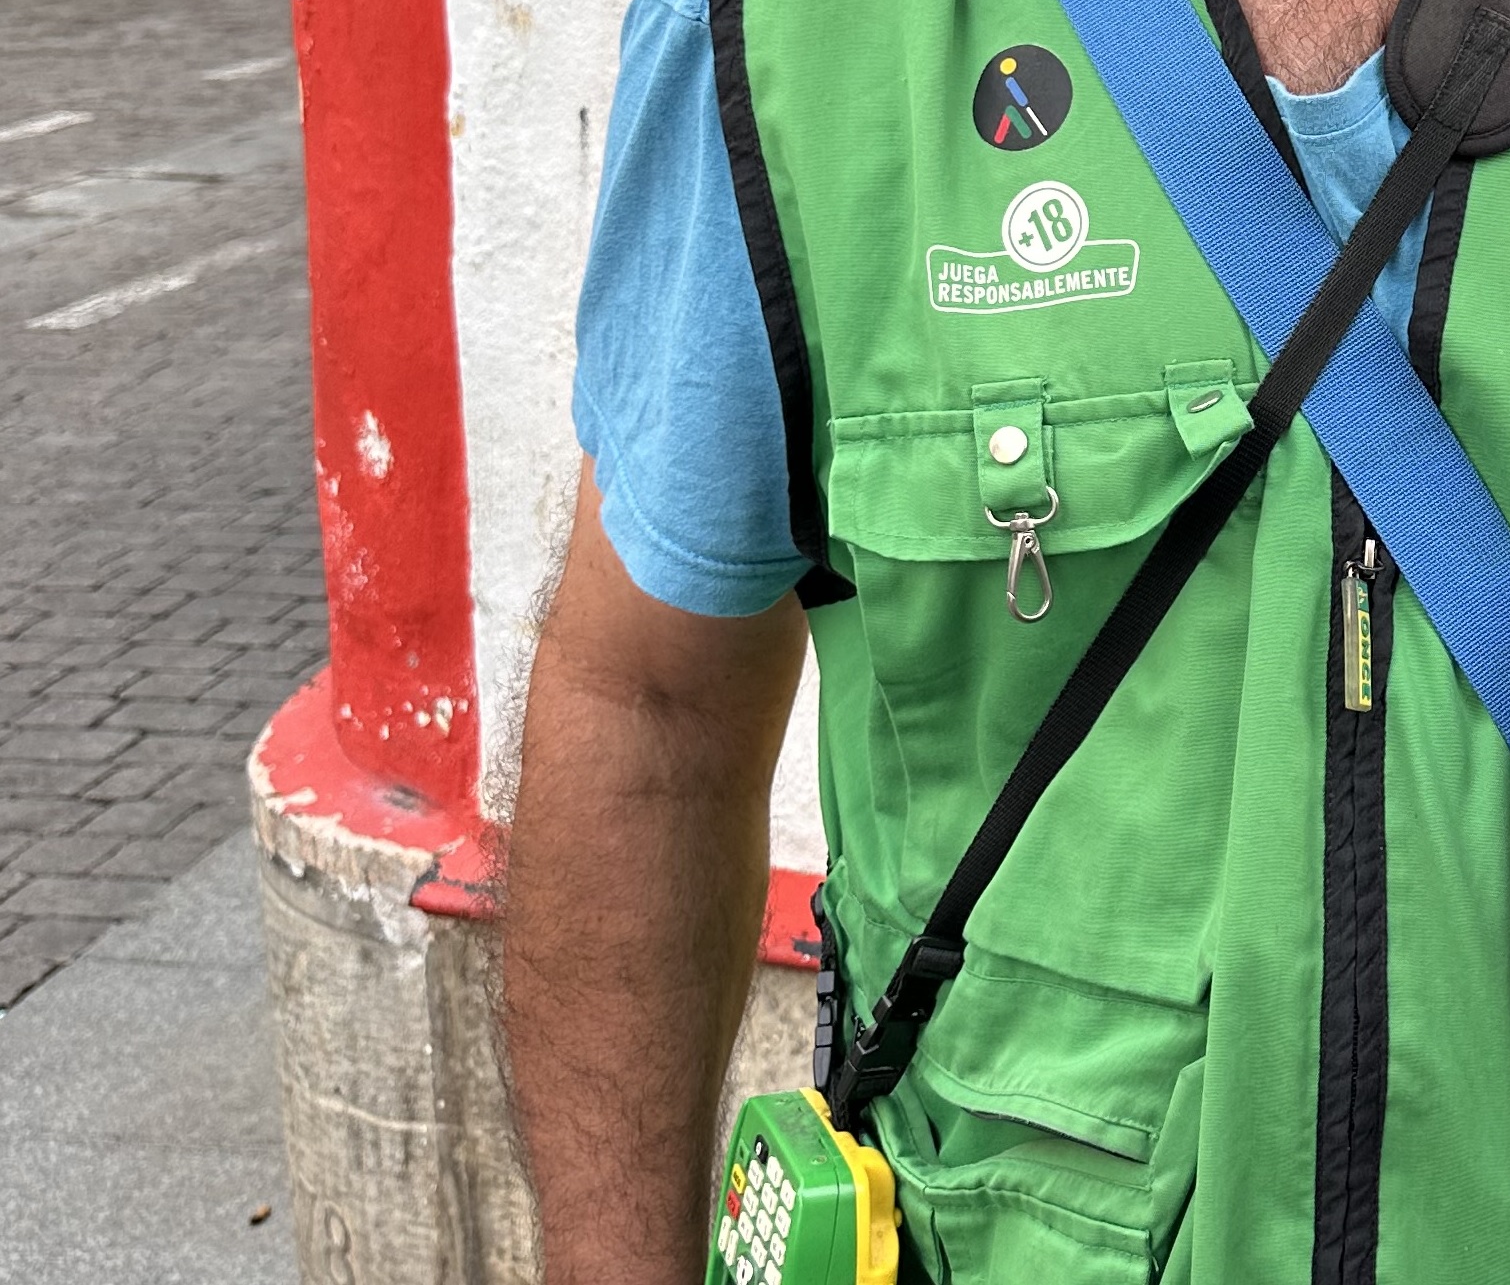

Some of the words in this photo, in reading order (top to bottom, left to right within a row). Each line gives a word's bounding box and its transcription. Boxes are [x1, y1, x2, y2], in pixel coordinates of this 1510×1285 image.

[1018, 198, 1073, 252] +18
[938, 262, 999, 284] JUEGA
[938, 267, 1131, 304] RESPONSABLEMENTE
